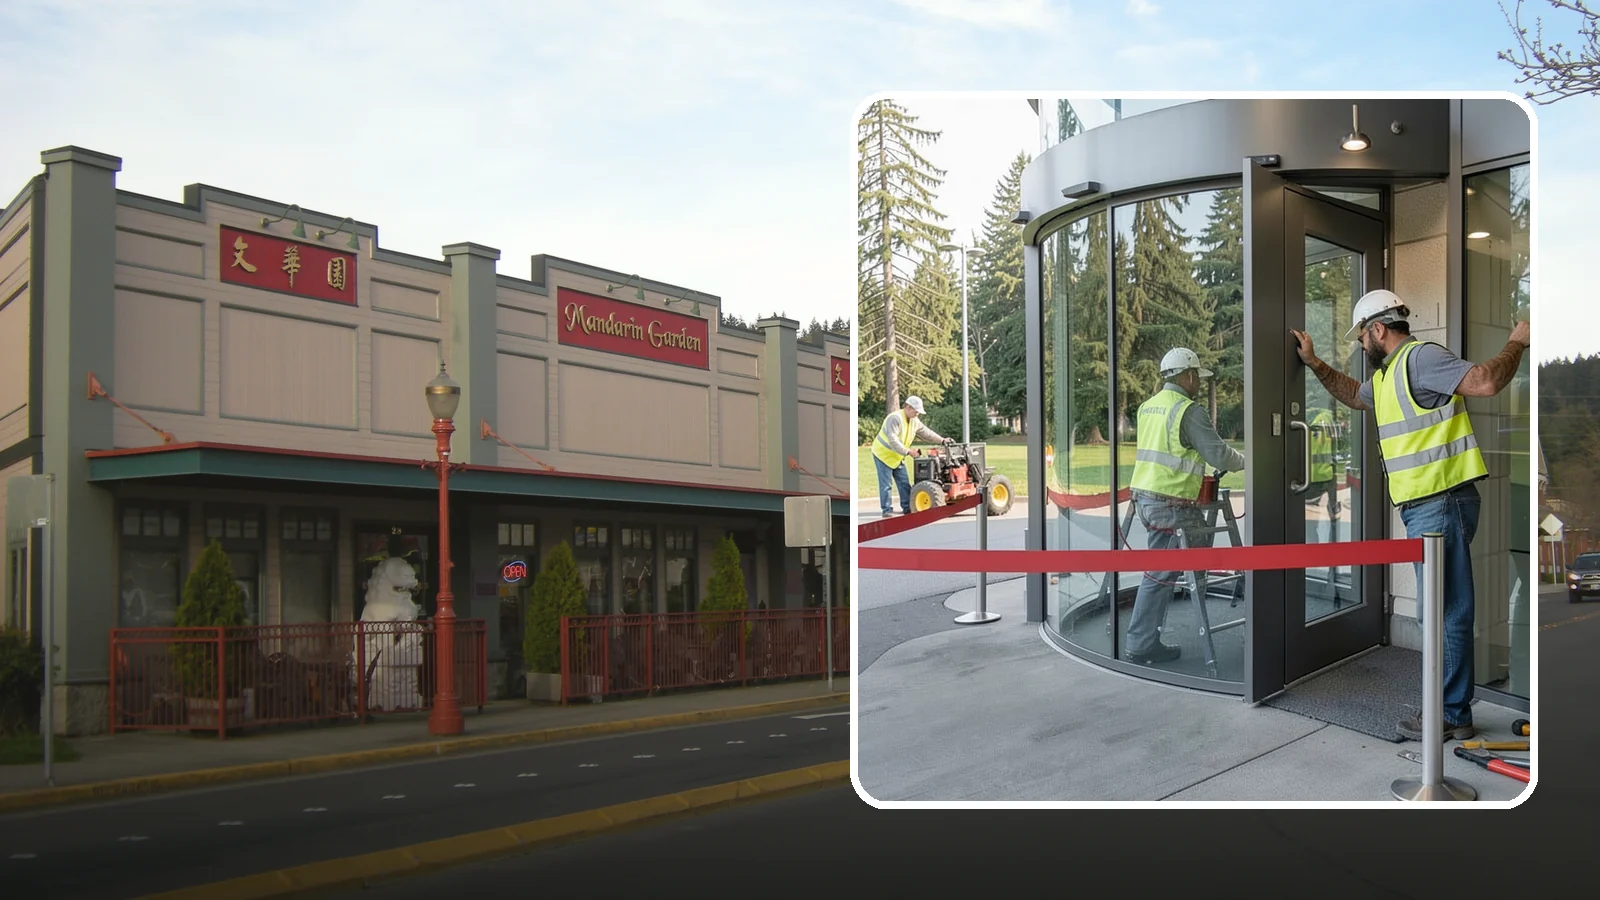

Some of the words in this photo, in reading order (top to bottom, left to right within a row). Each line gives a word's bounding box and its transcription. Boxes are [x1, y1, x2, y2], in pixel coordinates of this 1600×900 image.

[231, 235, 346, 291] 文華園
[564, 302, 644, 341] Mandarin
[648, 320, 701, 352] Garden
[503, 565, 526, 578] OPEN
